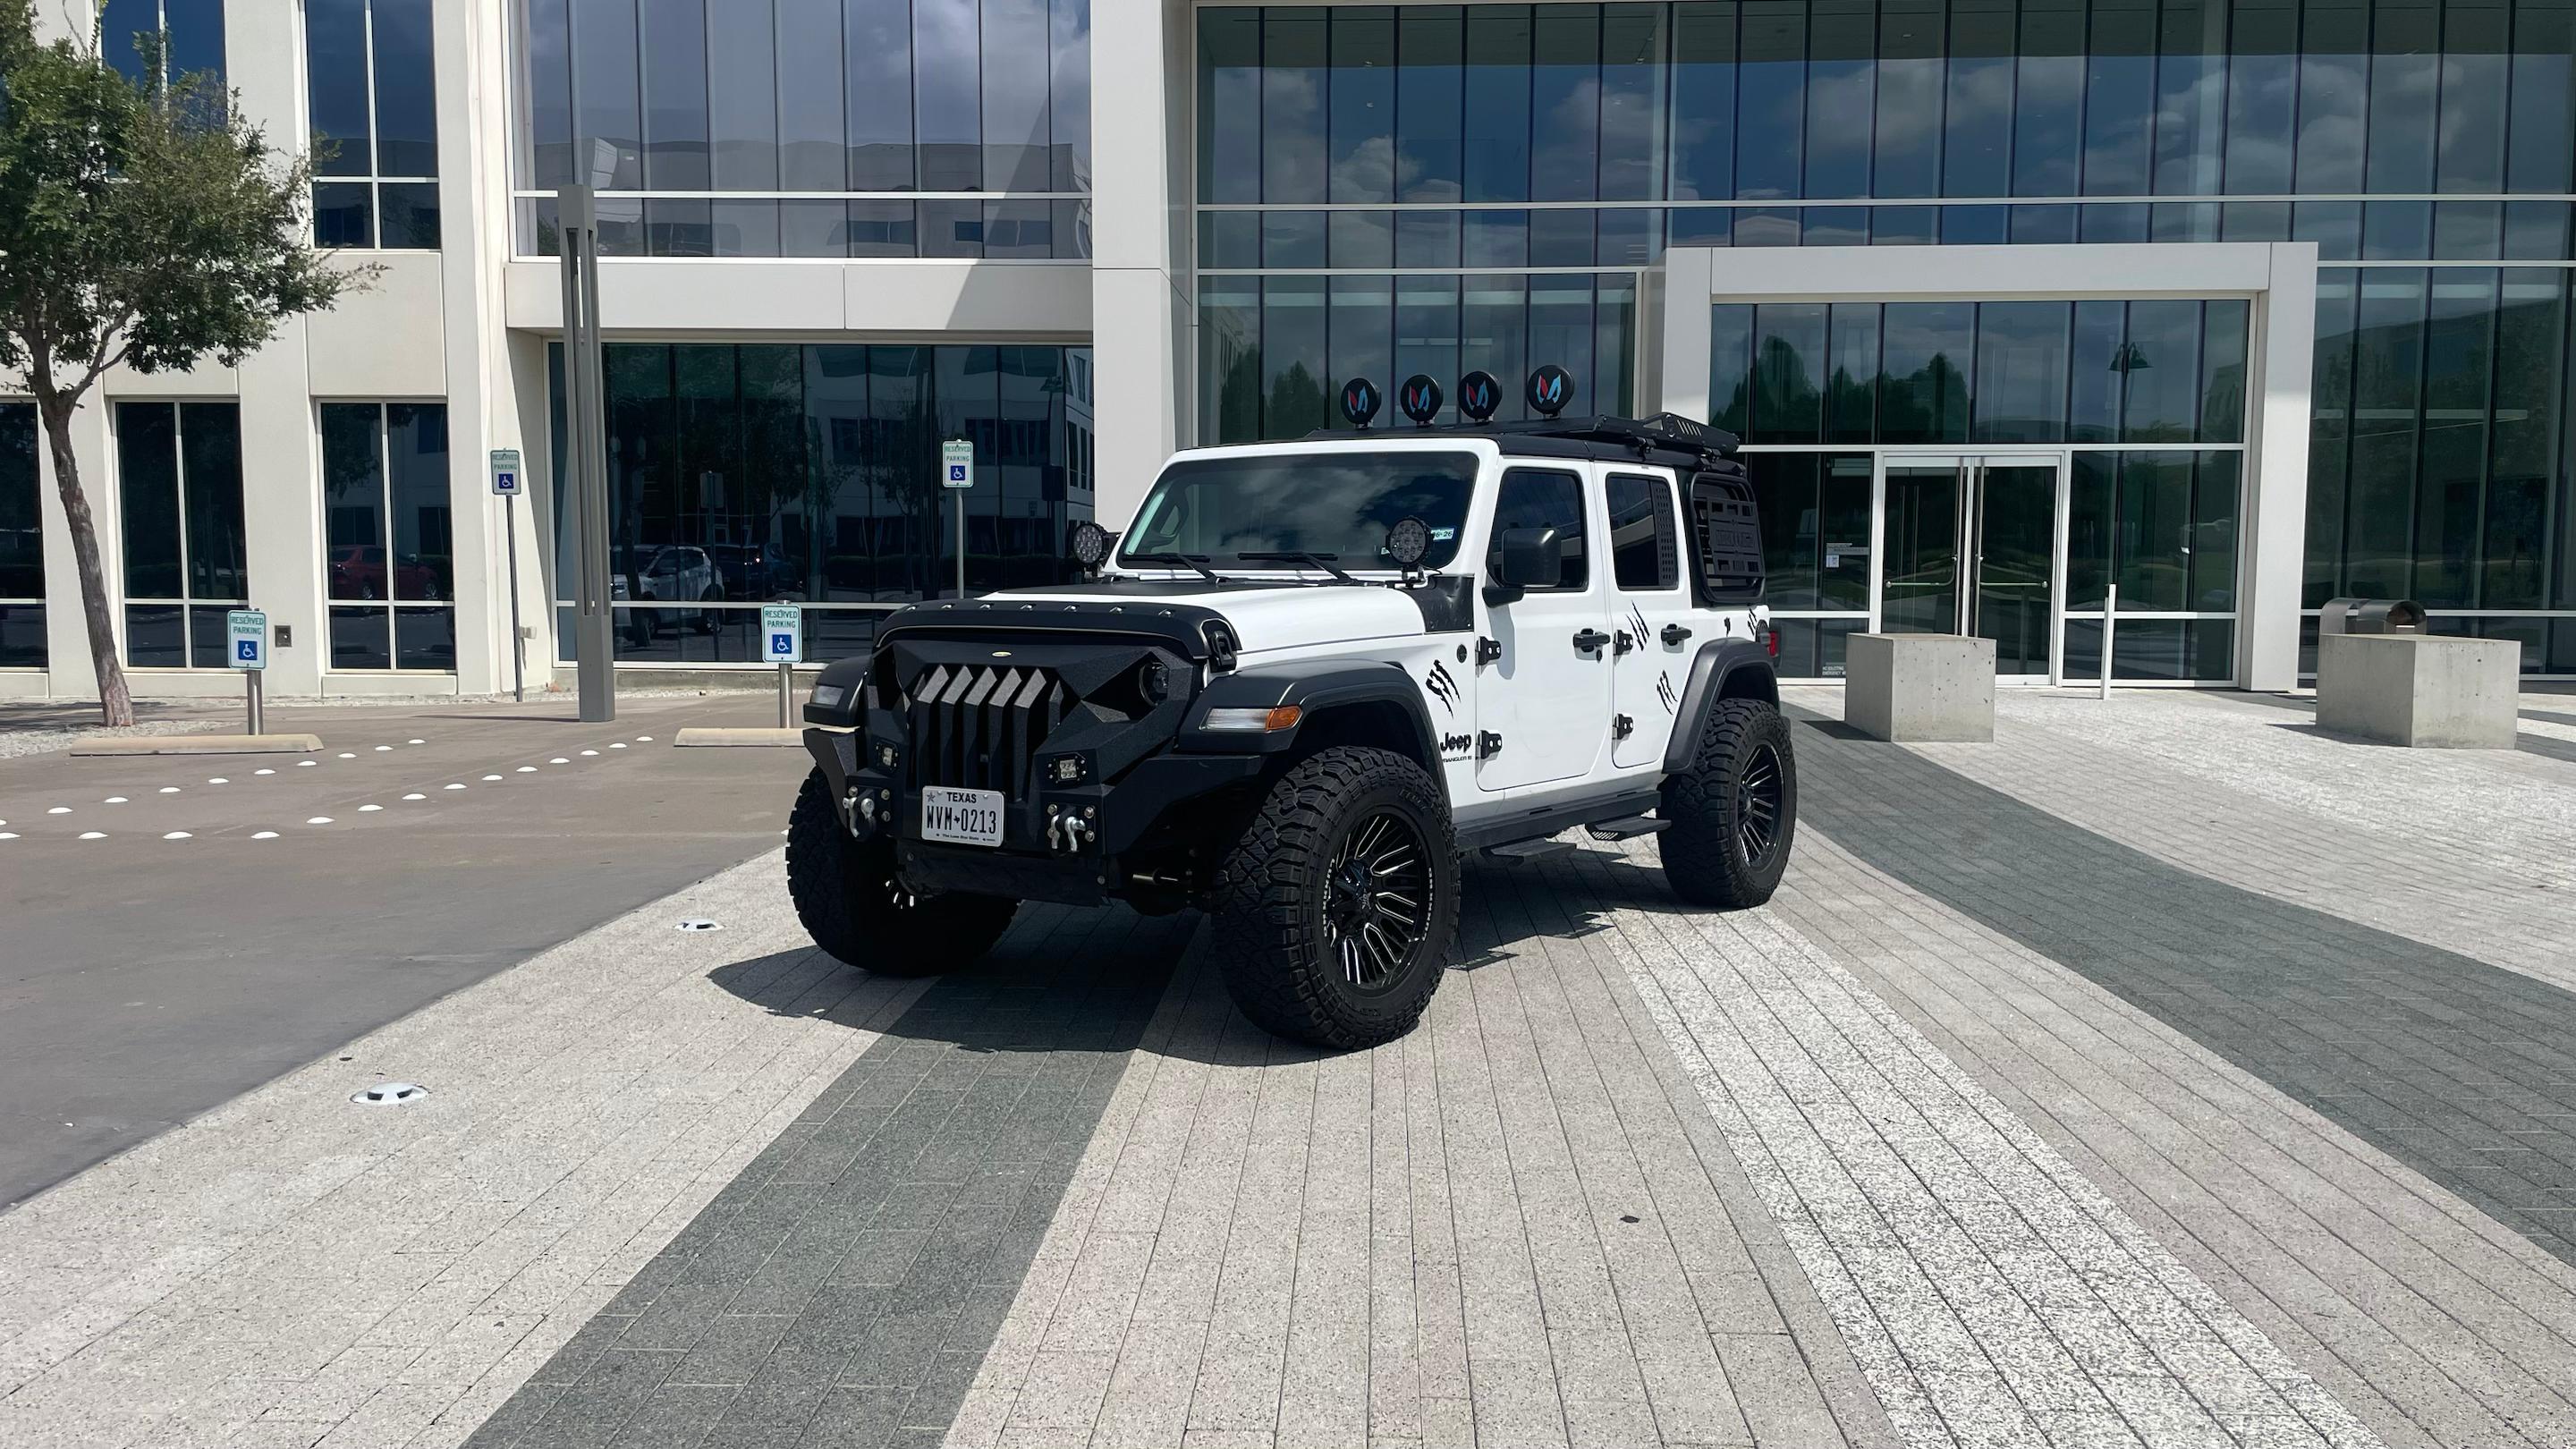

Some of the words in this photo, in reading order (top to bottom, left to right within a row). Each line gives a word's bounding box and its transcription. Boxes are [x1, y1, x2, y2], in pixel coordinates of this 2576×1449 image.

[765, 610, 798, 618] RESERVED
[230, 617, 264, 625] RESERVED
[767, 620, 796, 628] PARKING
[233, 626, 262, 634] PARKING
[1440, 732, 1471, 752] Jeep
[947, 792, 977, 803] TEXAS
